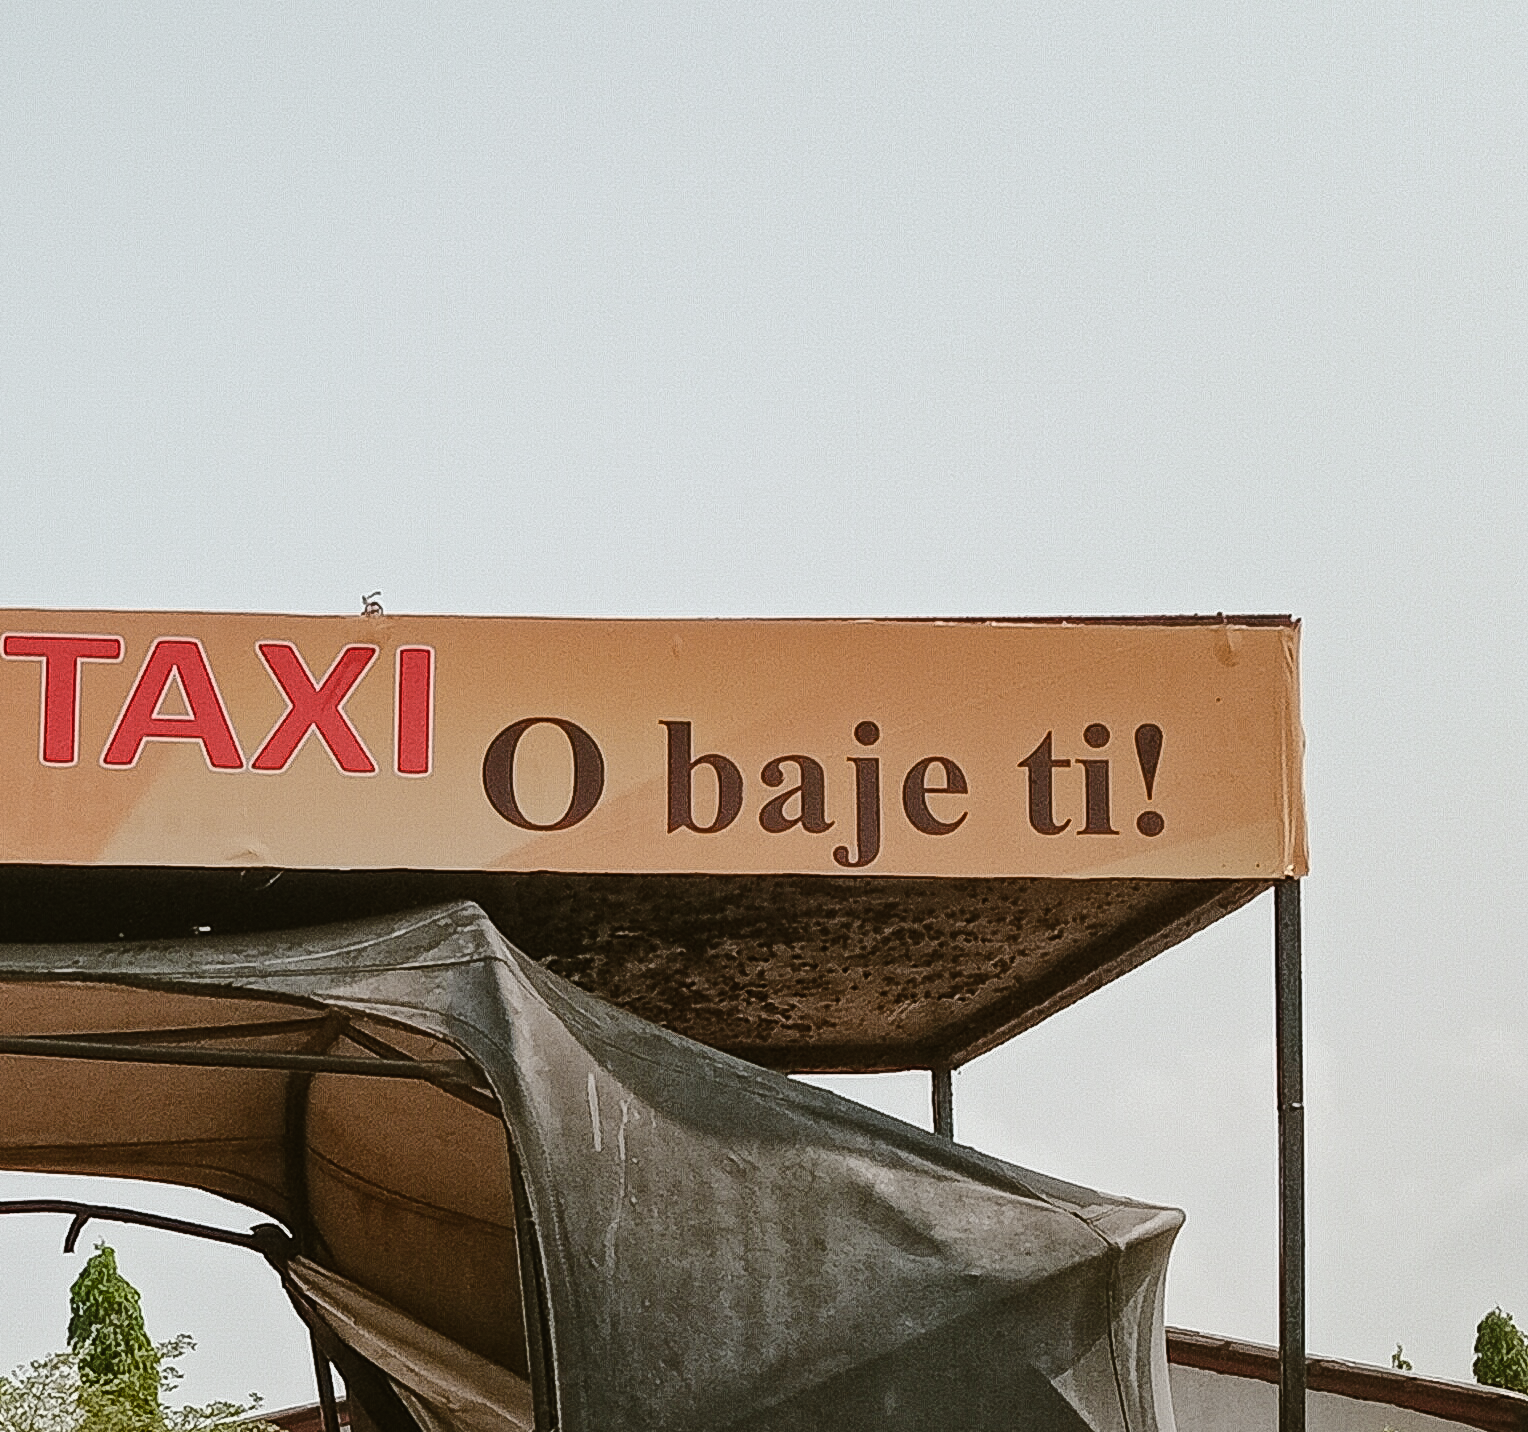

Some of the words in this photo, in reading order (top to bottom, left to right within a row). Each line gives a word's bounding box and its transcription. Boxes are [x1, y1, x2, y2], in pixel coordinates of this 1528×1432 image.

[1, 633, 434, 777] TAXI
[481, 716, 606, 832] O
[658, 719, 969, 868] baje
[1017, 722, 1165, 838] ti!
